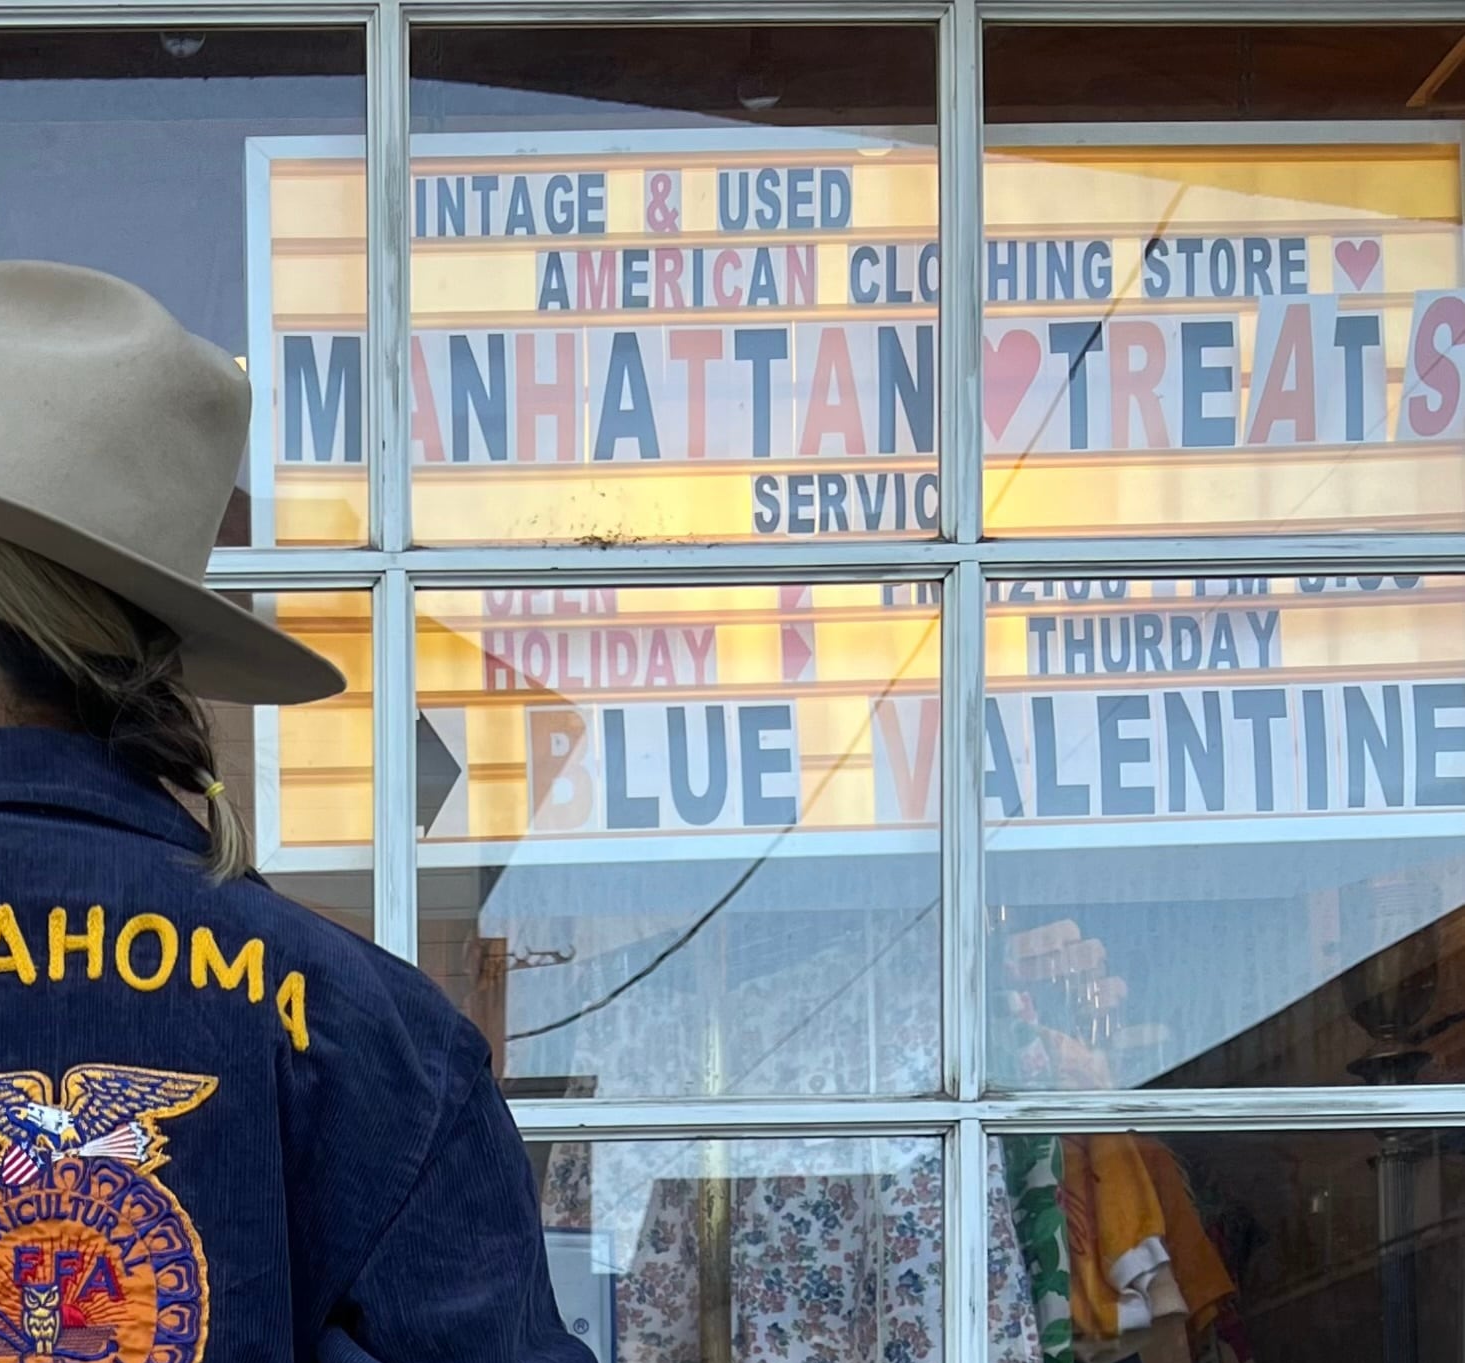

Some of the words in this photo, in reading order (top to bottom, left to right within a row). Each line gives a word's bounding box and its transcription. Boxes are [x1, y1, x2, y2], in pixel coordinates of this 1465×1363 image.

[415, 173, 605, 237] INTAGE
[647, 173, 678, 232] &
[718, 167, 851, 232] USED
[538, 244, 816, 310] AMERICAN
[850, 238, 1112, 303] CLOHING
[1143, 237, 1307, 298] STORE
[283, 325, 934, 463] MANHATTAN
[1048, 295, 1465, 450] TREATS
[754, 473, 938, 533] SERVIC
[484, 624, 716, 691] HOLIDAY
[1029, 610, 1279, 675] THURDAY
[529, 704, 797, 831] BLUE
[873, 684, 1465, 821] VALENTINE
[14, 1246, 125, 1303] FFA
